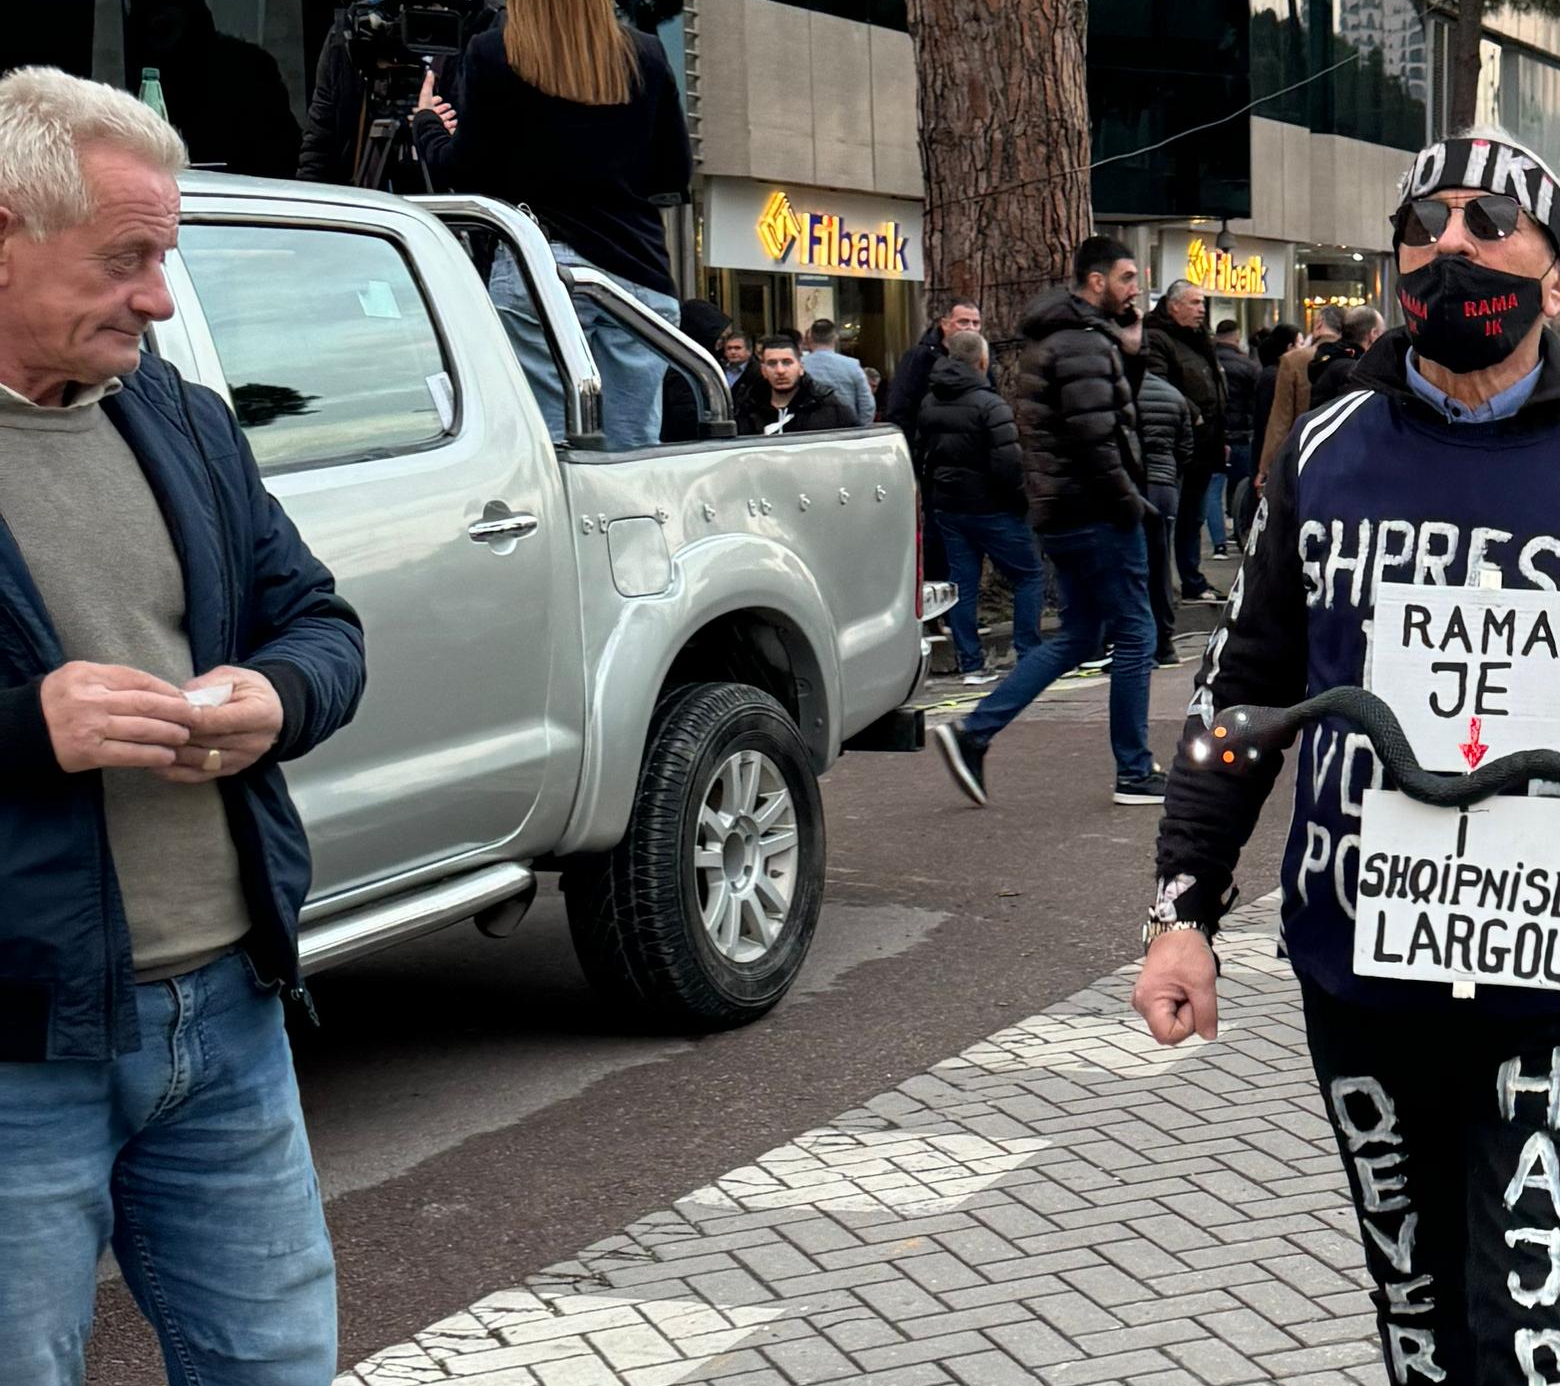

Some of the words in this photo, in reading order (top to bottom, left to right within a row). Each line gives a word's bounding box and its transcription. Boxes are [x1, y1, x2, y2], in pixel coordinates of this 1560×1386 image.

[800, 212, 909, 272] Fibank
[1208, 251, 1268, 293] Fibank
[1464, 292, 1519, 317] RAMA
[1484, 318, 1503, 336] IK
[1401, 603, 1559, 660] RAMA
[1429, 661, 1512, 719] JE
